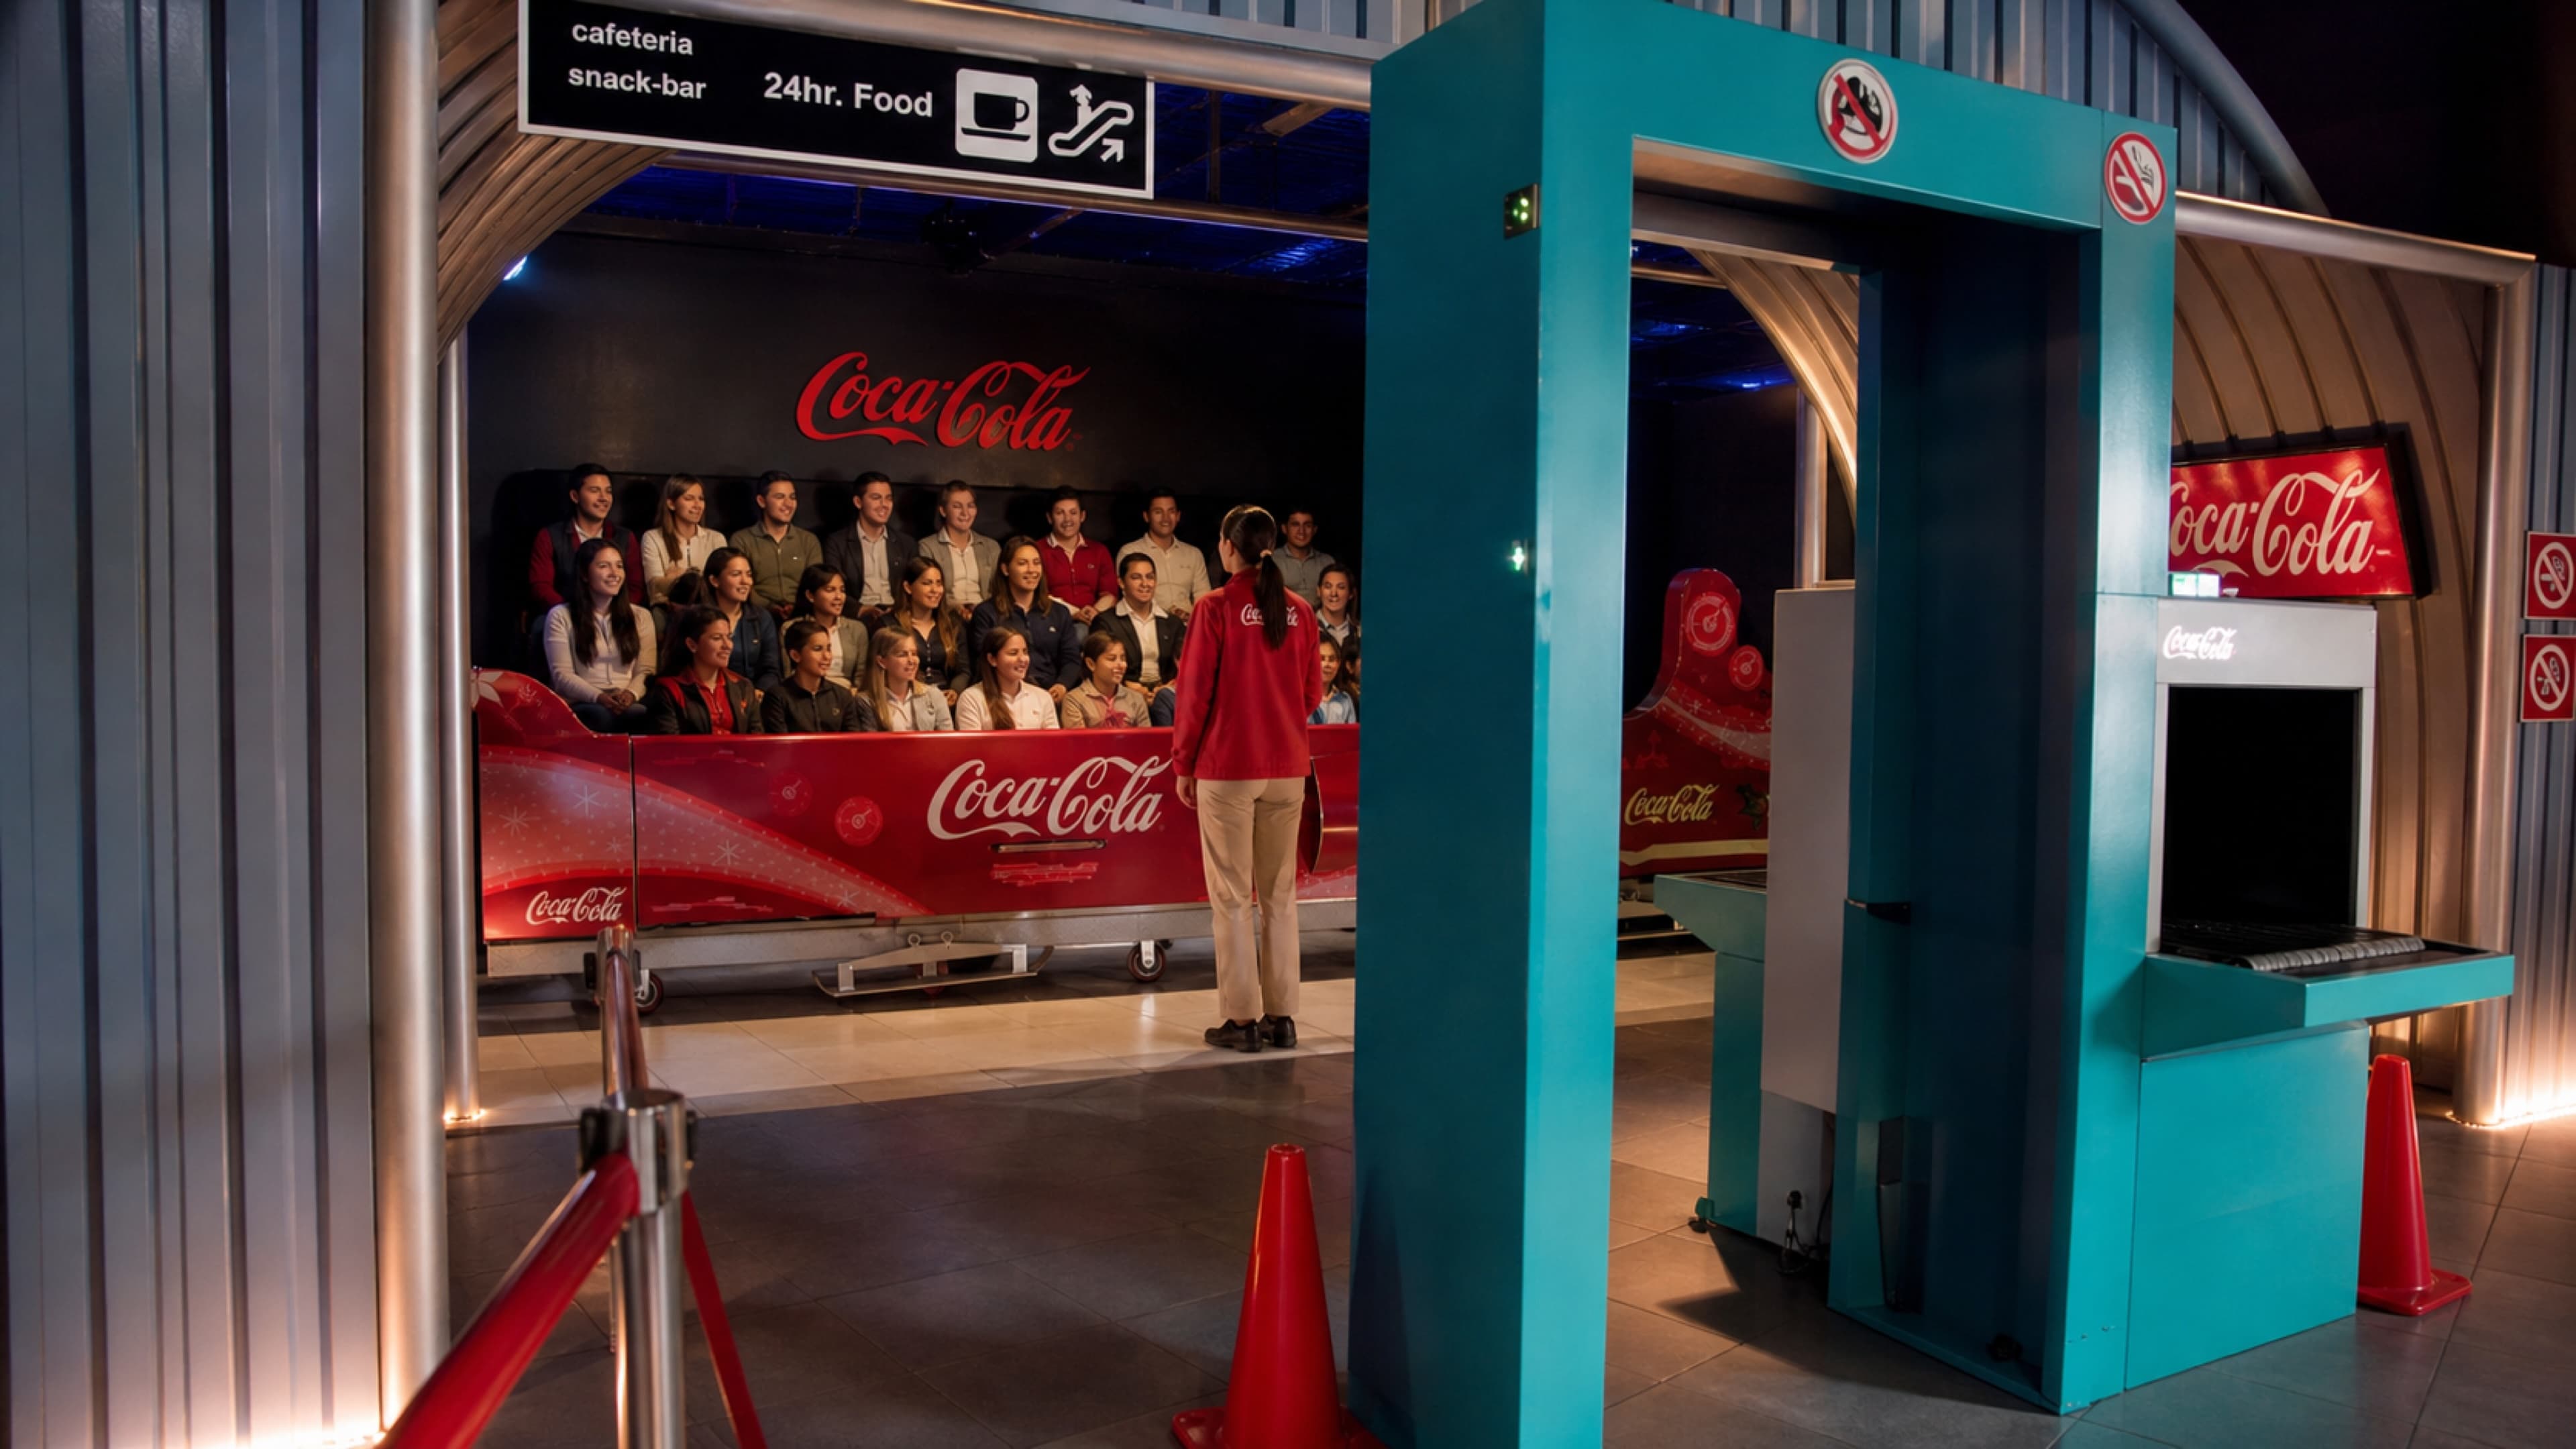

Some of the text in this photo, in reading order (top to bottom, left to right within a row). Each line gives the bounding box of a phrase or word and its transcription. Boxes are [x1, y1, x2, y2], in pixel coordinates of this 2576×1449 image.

[572, 23, 693, 55] cafeteria
[568, 68, 706, 99] snack-bar
[763, 72, 932, 117] 24hr. Food
[796, 352, 1091, 450] Coca-Cola
[2163, 625, 2237, 659] Coca-Cola
[927, 755, 1173, 840] Coca-Cola
[1625, 784, 1719, 826] Coca-Cola
[526, 887, 627, 925] Coca-Cola
